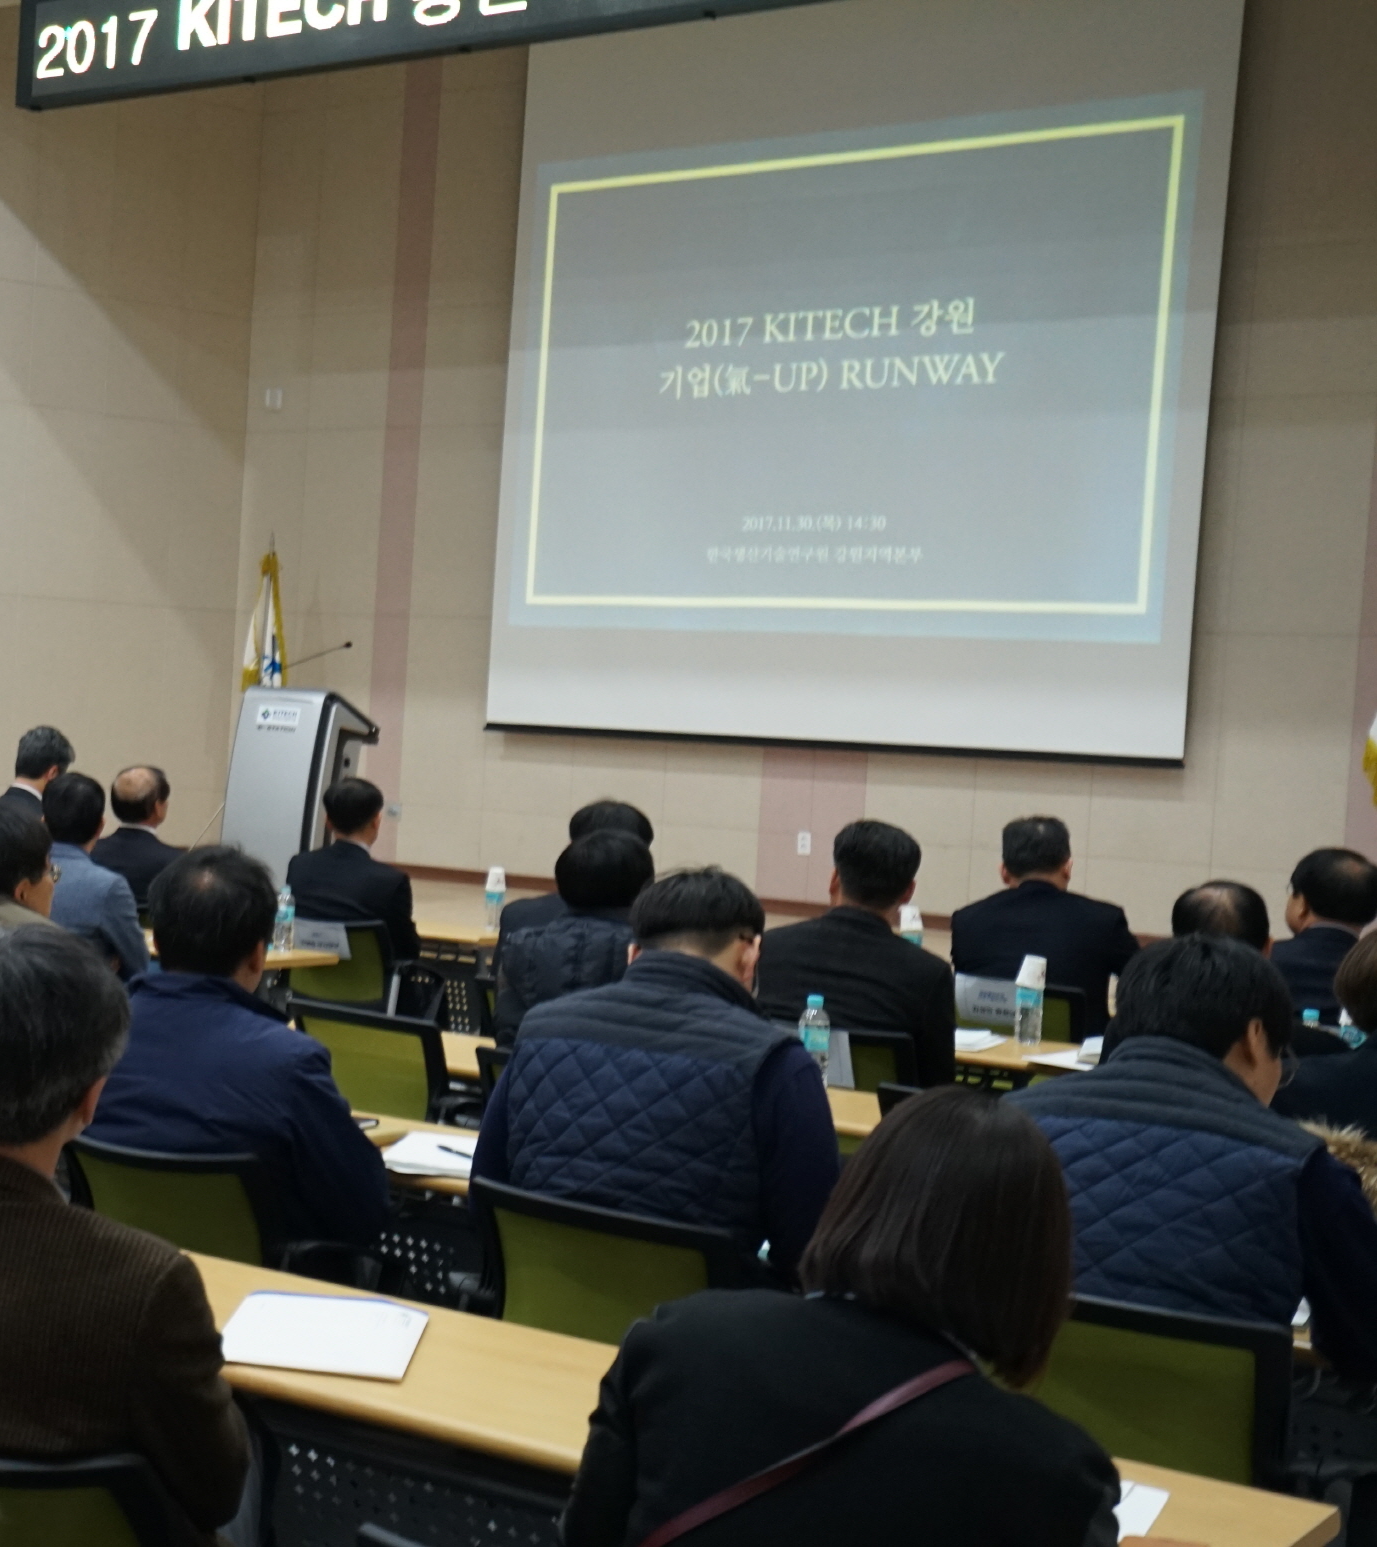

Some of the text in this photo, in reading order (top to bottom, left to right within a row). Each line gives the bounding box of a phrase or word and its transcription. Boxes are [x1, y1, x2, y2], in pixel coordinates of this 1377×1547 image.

[35, 9, 158, 79] 2017
[684, 296, 975, 349] 2017 KITECH 강원
[839, 351, 1006, 390] RUNWAY
